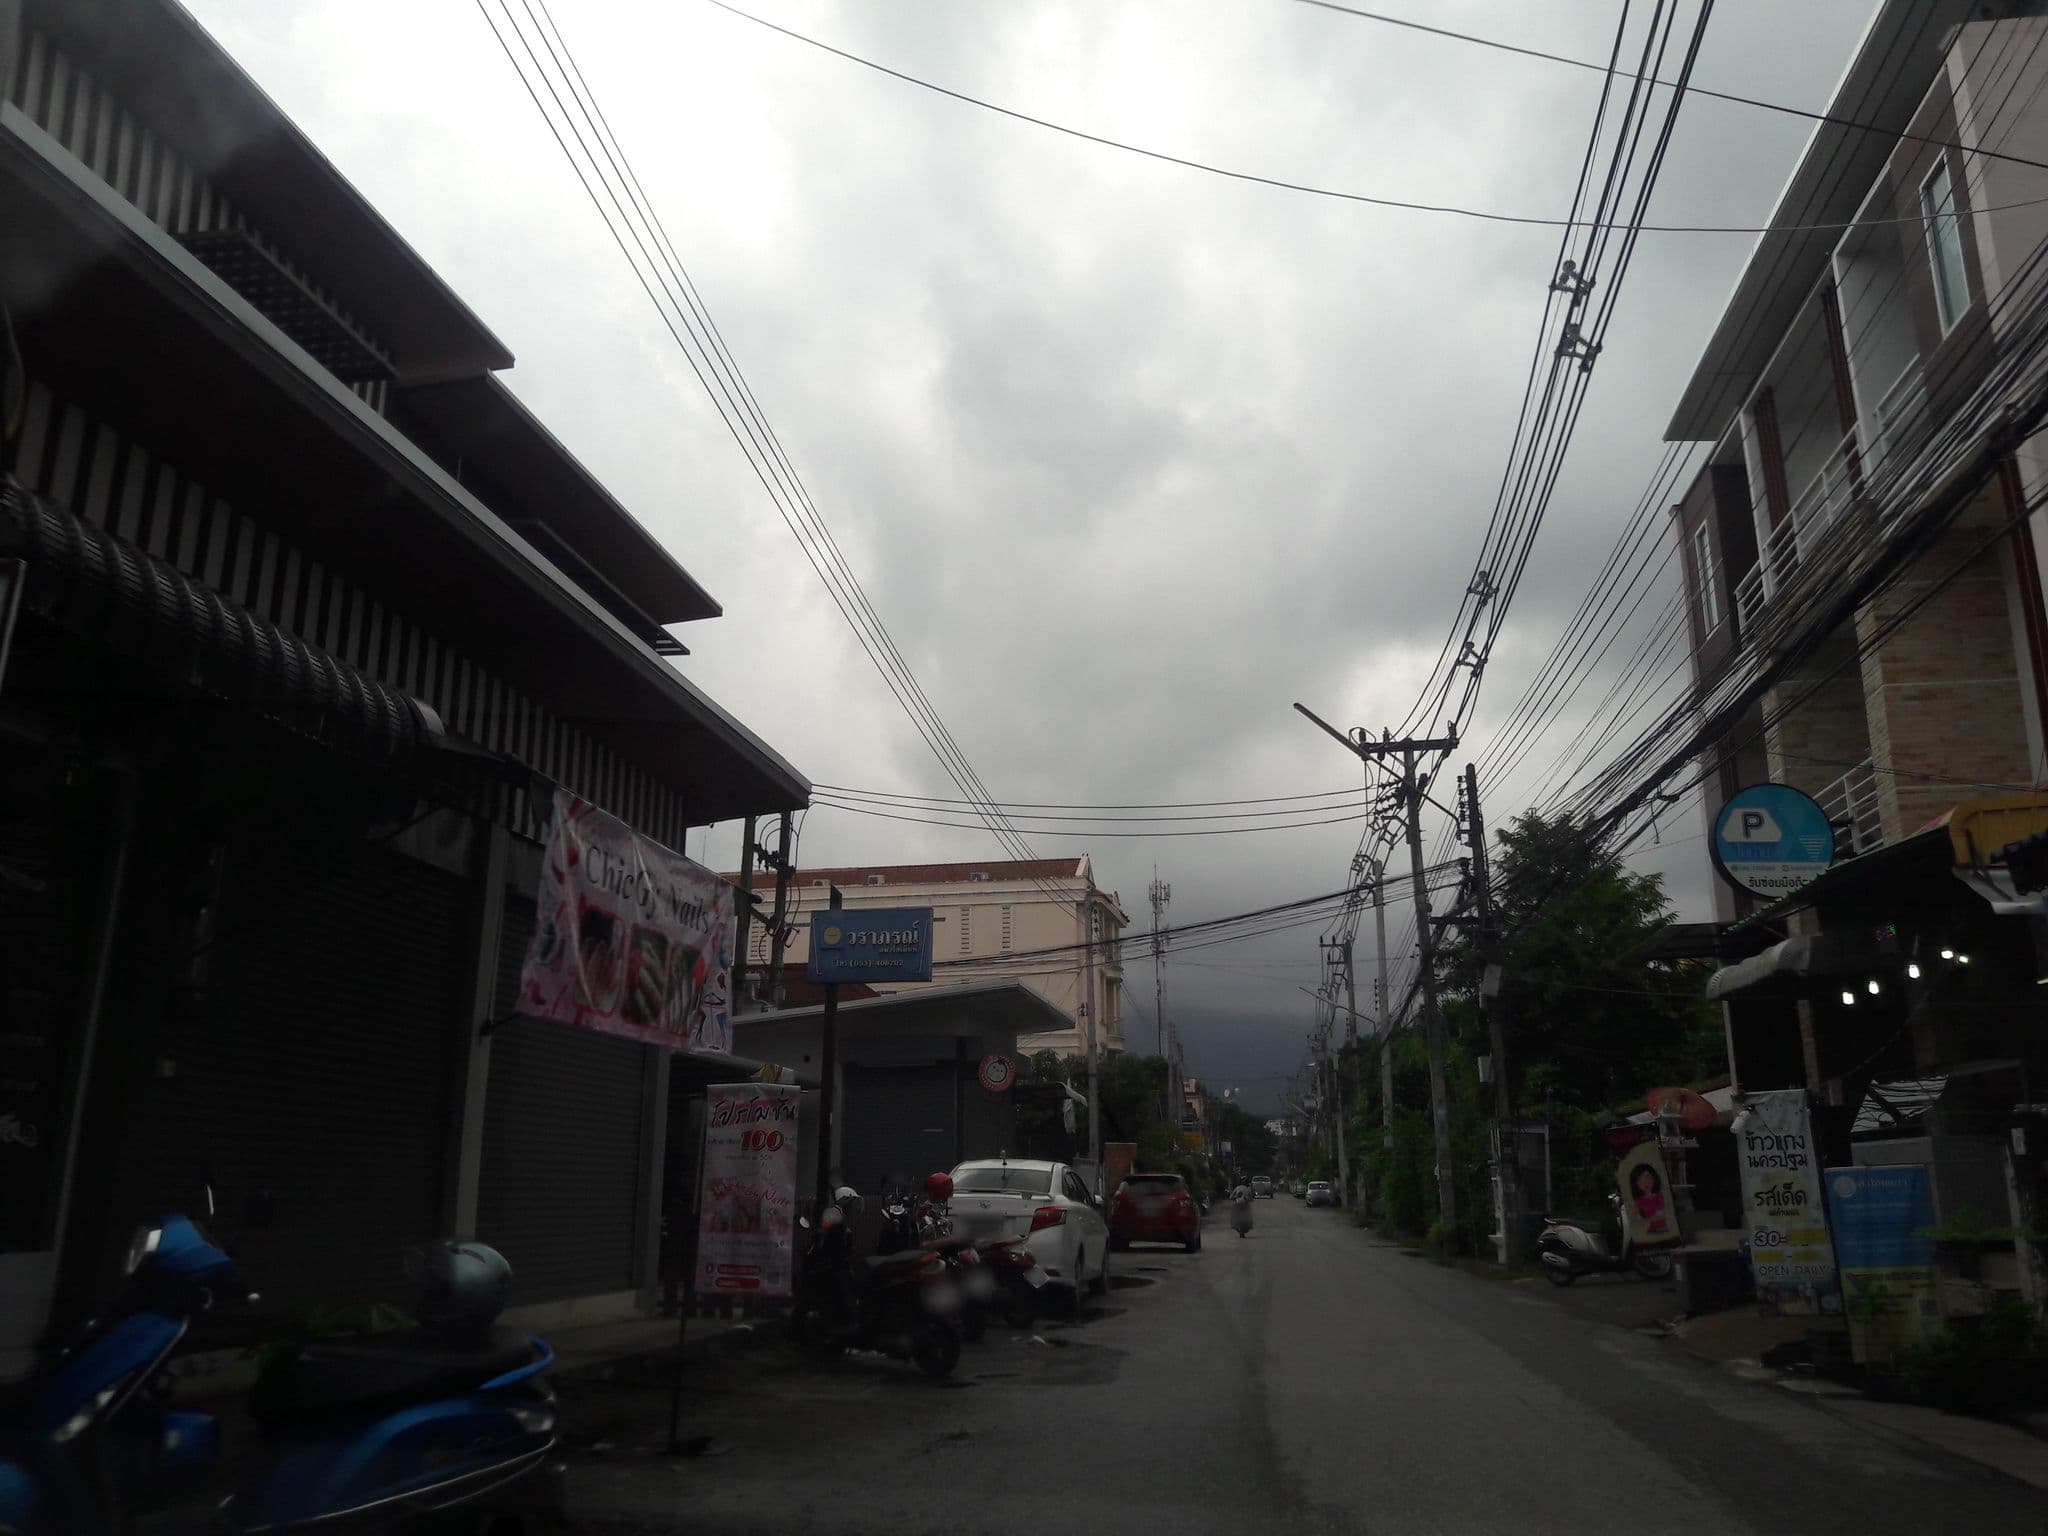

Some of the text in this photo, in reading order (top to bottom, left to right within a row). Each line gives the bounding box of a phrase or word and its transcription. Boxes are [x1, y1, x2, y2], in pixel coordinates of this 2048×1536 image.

[669, 884, 710, 935] Nails
[847, 920, 922, 945] วราภรณ์
[711, 1088, 796, 1126] โปรโมชั่น
[740, 1129, 785, 1151] 100
[1745, 1130, 1806, 1151] ข้าวแกง
[1747, 1152, 1808, 1171] นครปฐม
[1754, 1182, 1808, 1206] รสเด็ด
[1758, 1265, 1789, 1276] OPEN
